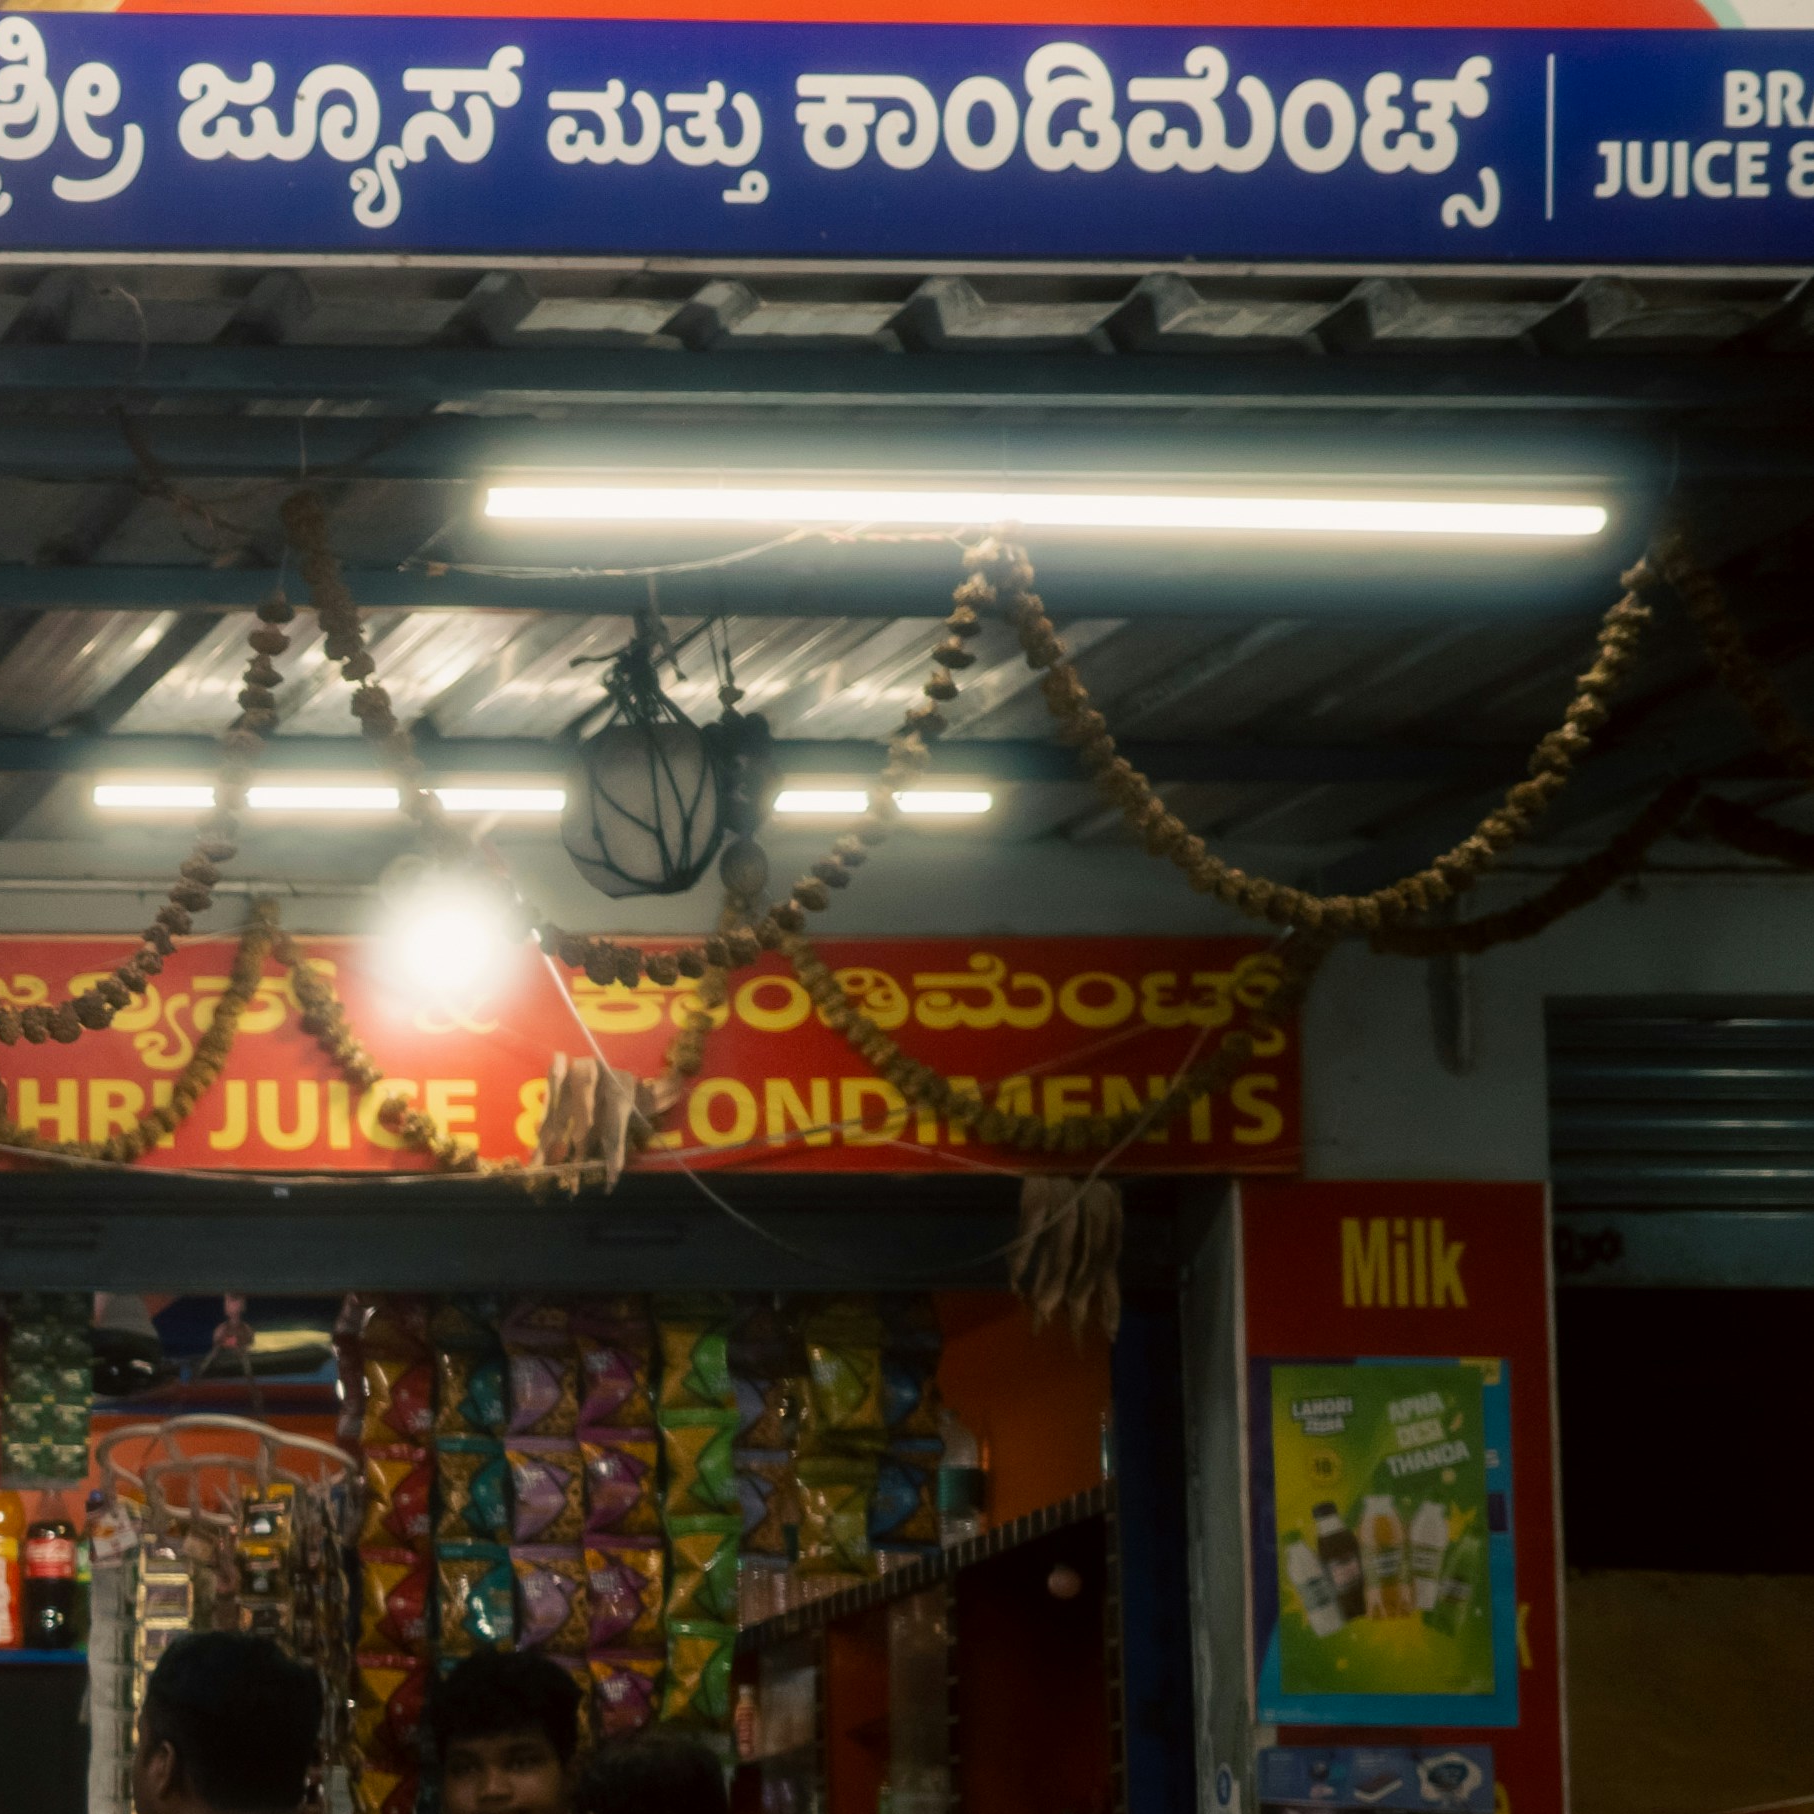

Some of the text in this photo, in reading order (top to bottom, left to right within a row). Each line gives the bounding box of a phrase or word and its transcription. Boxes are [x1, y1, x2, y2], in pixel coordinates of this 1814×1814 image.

[546, 79, 771, 204] ಮತ್ತು
[1594, 140, 1771, 199] JUICE
[1341, 1217, 1469, 1308] Milk
